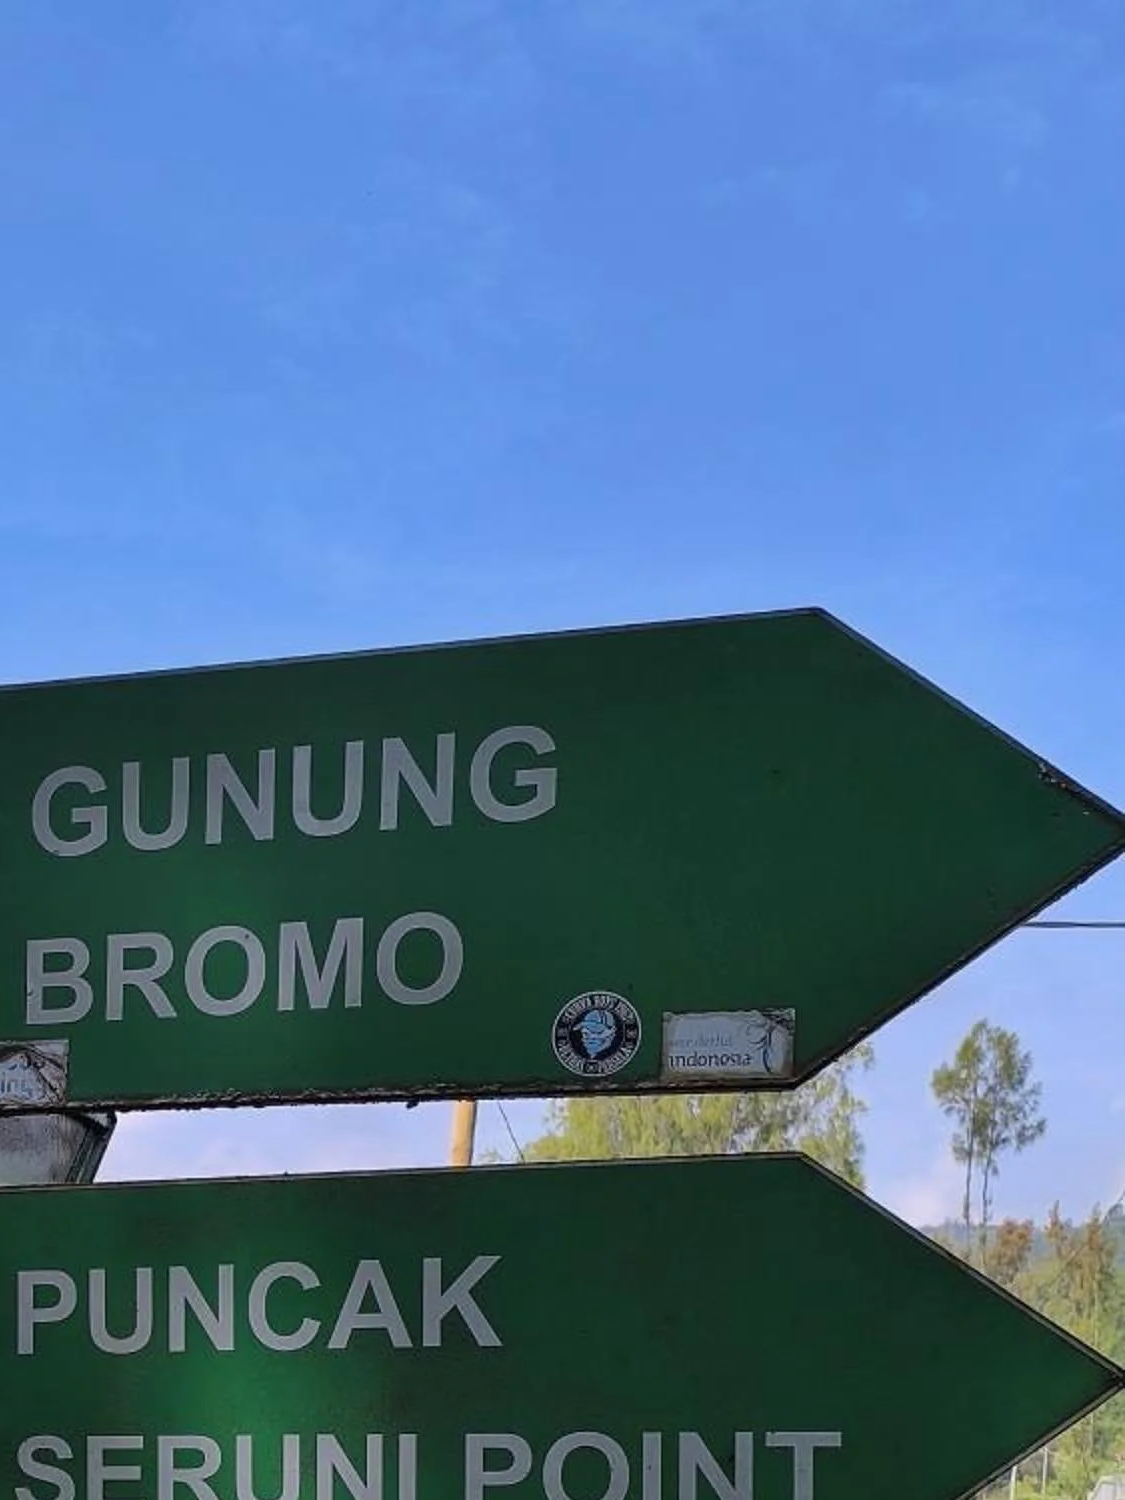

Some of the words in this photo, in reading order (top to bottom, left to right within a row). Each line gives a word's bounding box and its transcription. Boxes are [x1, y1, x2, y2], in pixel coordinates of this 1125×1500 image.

[32, 725, 558, 857] GUNUNG
[26, 911, 464, 1025] BROMO
[17, 1255, 503, 1355] PUNCAK
